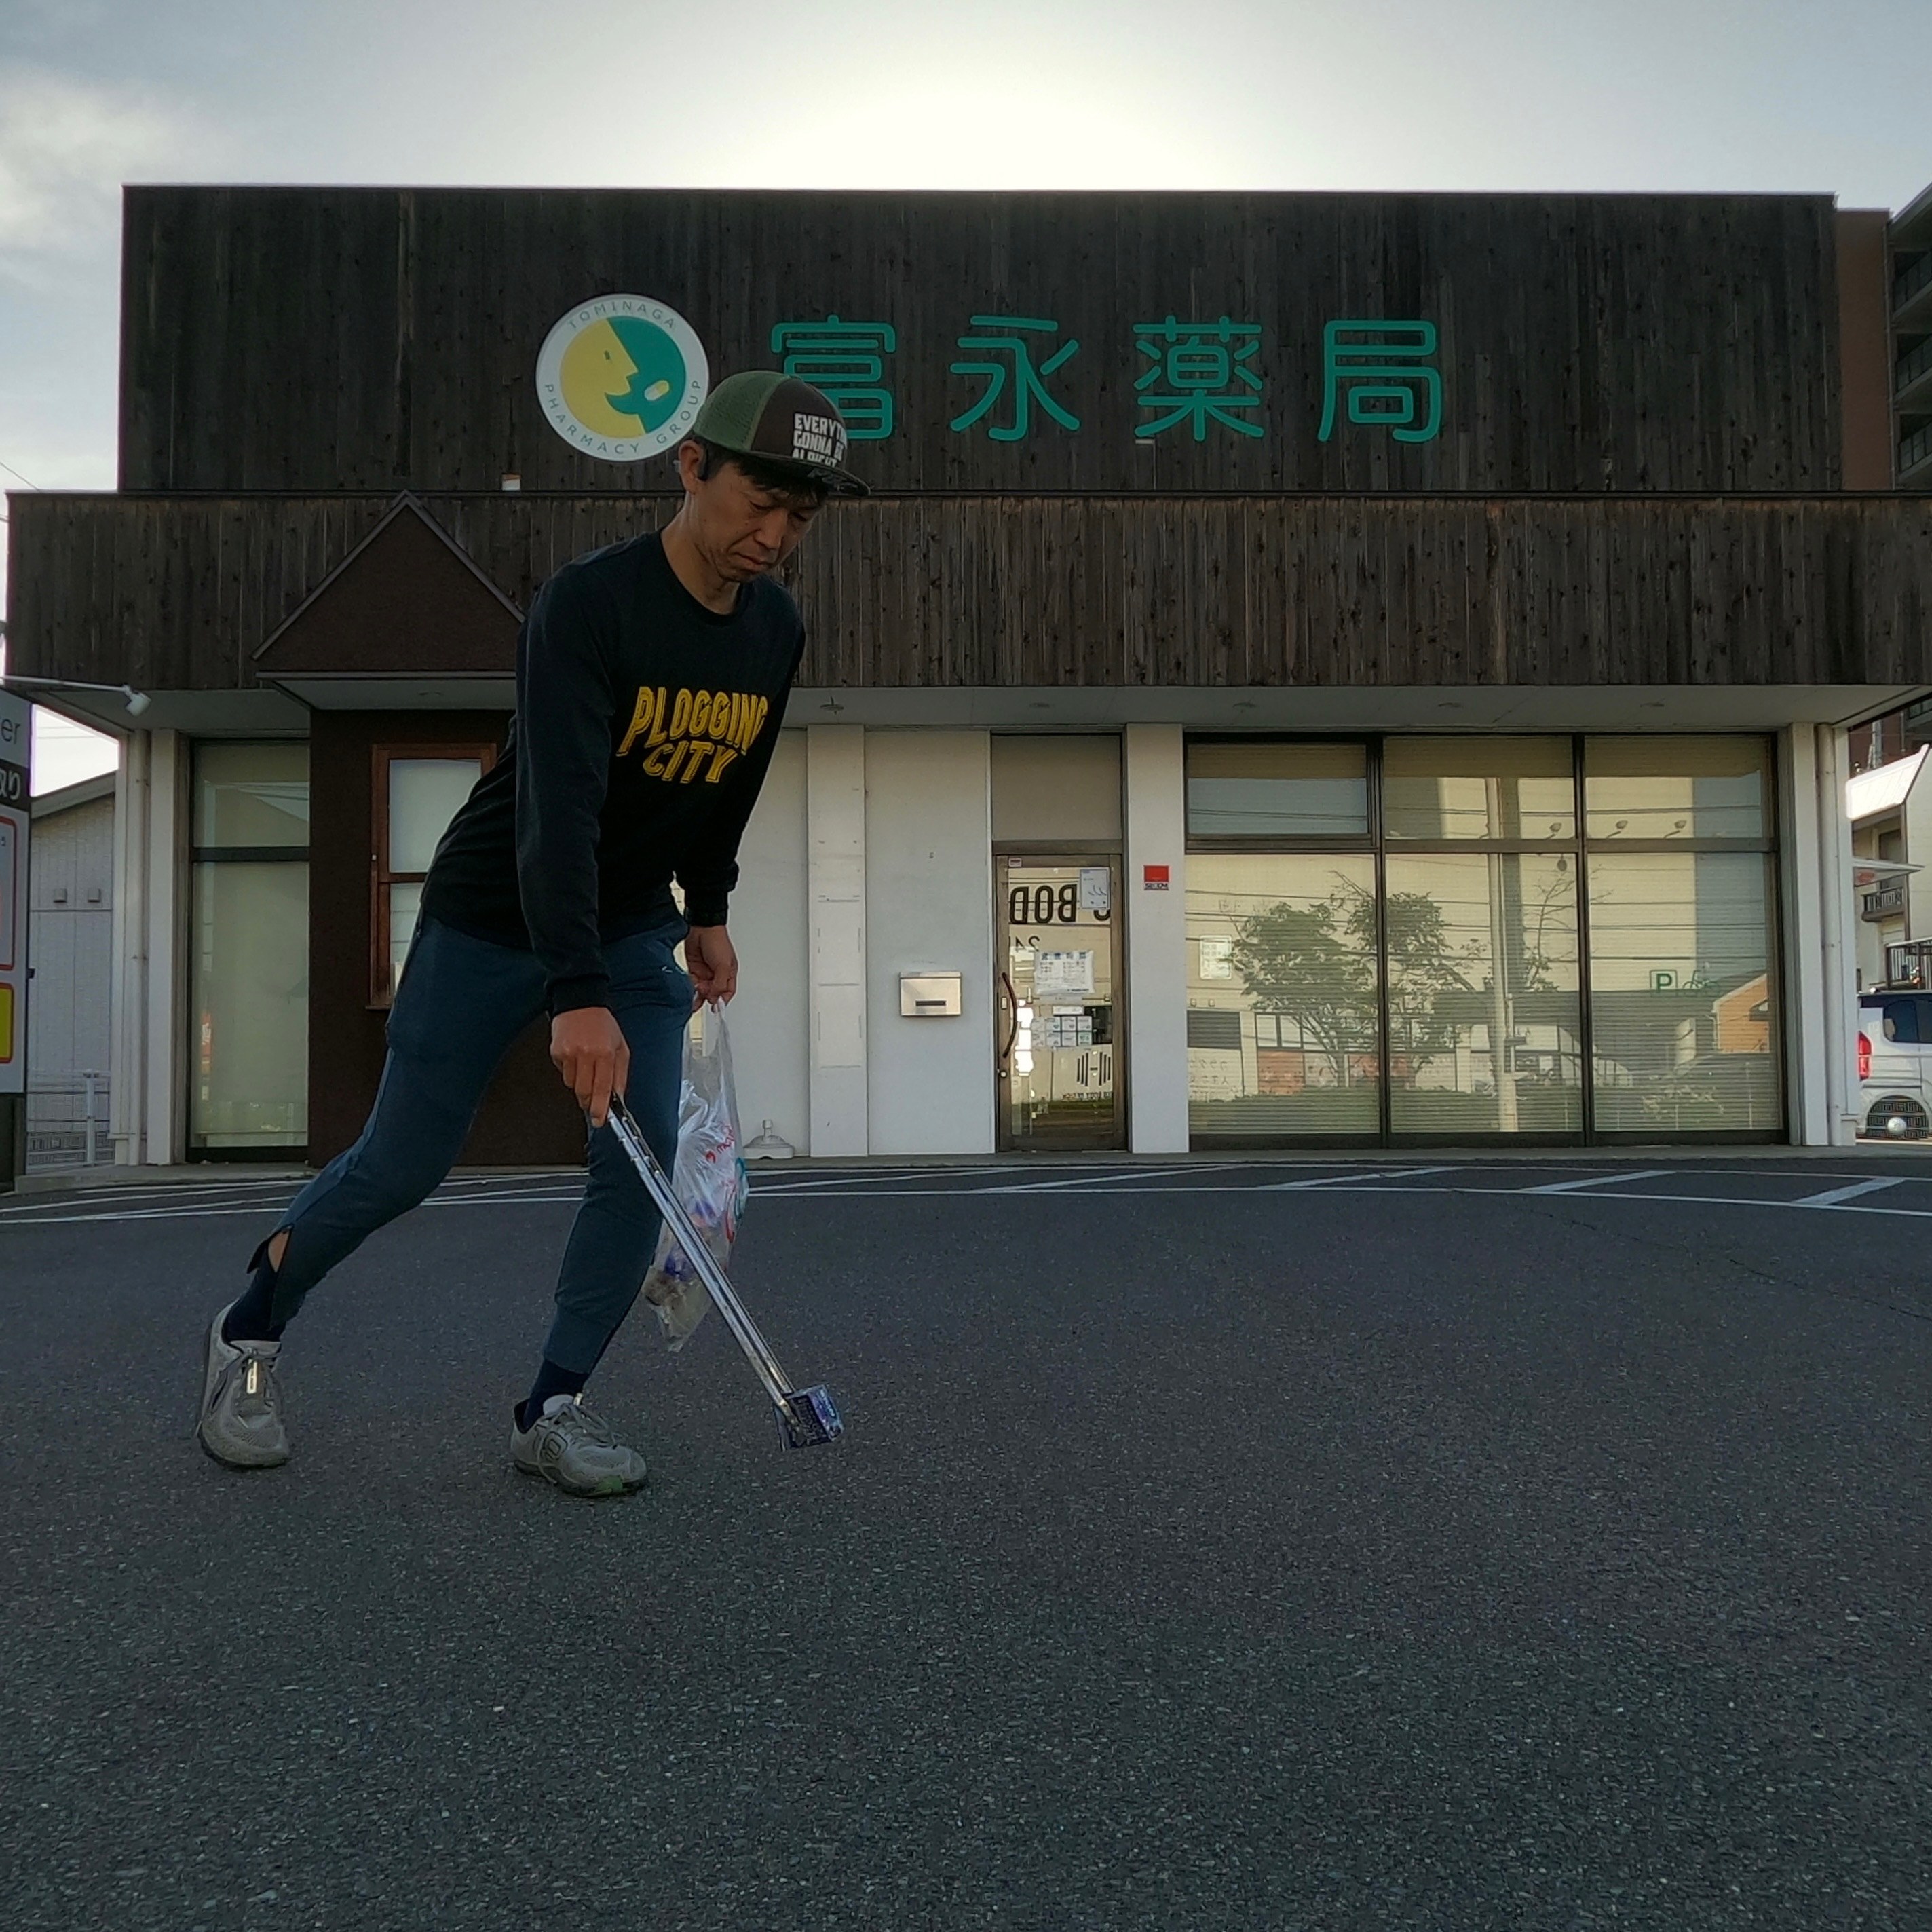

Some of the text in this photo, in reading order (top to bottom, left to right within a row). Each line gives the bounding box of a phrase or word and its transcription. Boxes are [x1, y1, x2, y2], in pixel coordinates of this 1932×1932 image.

[567, 301, 675, 330] TOMINAGA
[770, 314, 1443, 443] 富永薬局
[544, 379, 702, 455] PHARMACY GROUP
[793, 430, 832, 456] GONNA
[615, 686, 768, 757] PLOGGING
[643, 740, 738, 784] CITY
[1656, 973, 1672, 993] P
